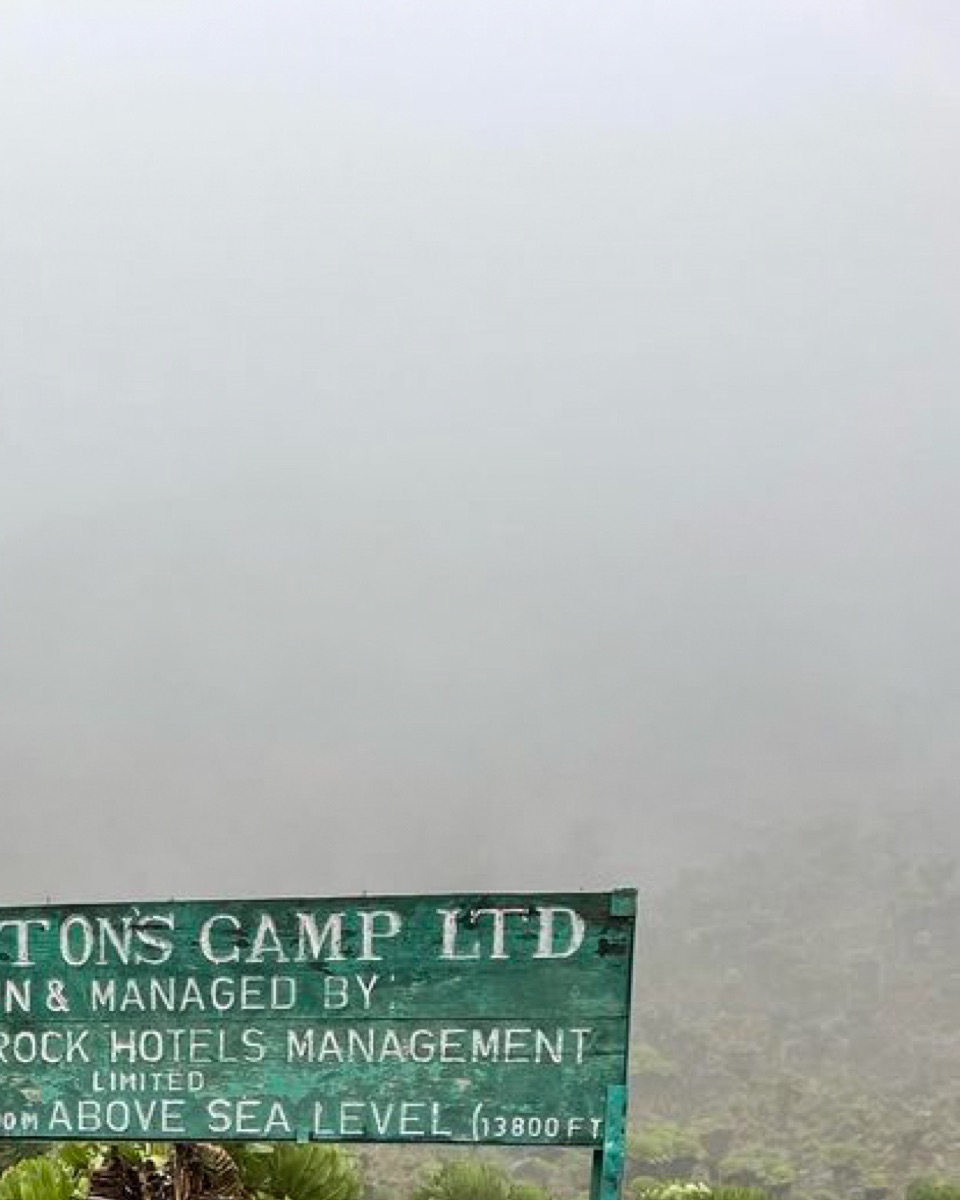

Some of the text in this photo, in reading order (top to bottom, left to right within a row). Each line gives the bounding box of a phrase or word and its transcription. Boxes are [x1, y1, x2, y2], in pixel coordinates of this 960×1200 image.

[199, 910, 403, 965] CAMP
[436, 906, 586, 960] LTD
[46, 979, 71, 1012] &
[92, 975, 297, 1012] MANAGED
[110, 1028, 267, 1064] HOTELS
[287, 1027, 593, 1065] MANAGEMENT
[92, 1070, 205, 1092] LIMITED
[48, 1099, 187, 1134] ABOVE
[208, 1098, 292, 1136] SEA
[313, 1100, 453, 1137] LEVEL
